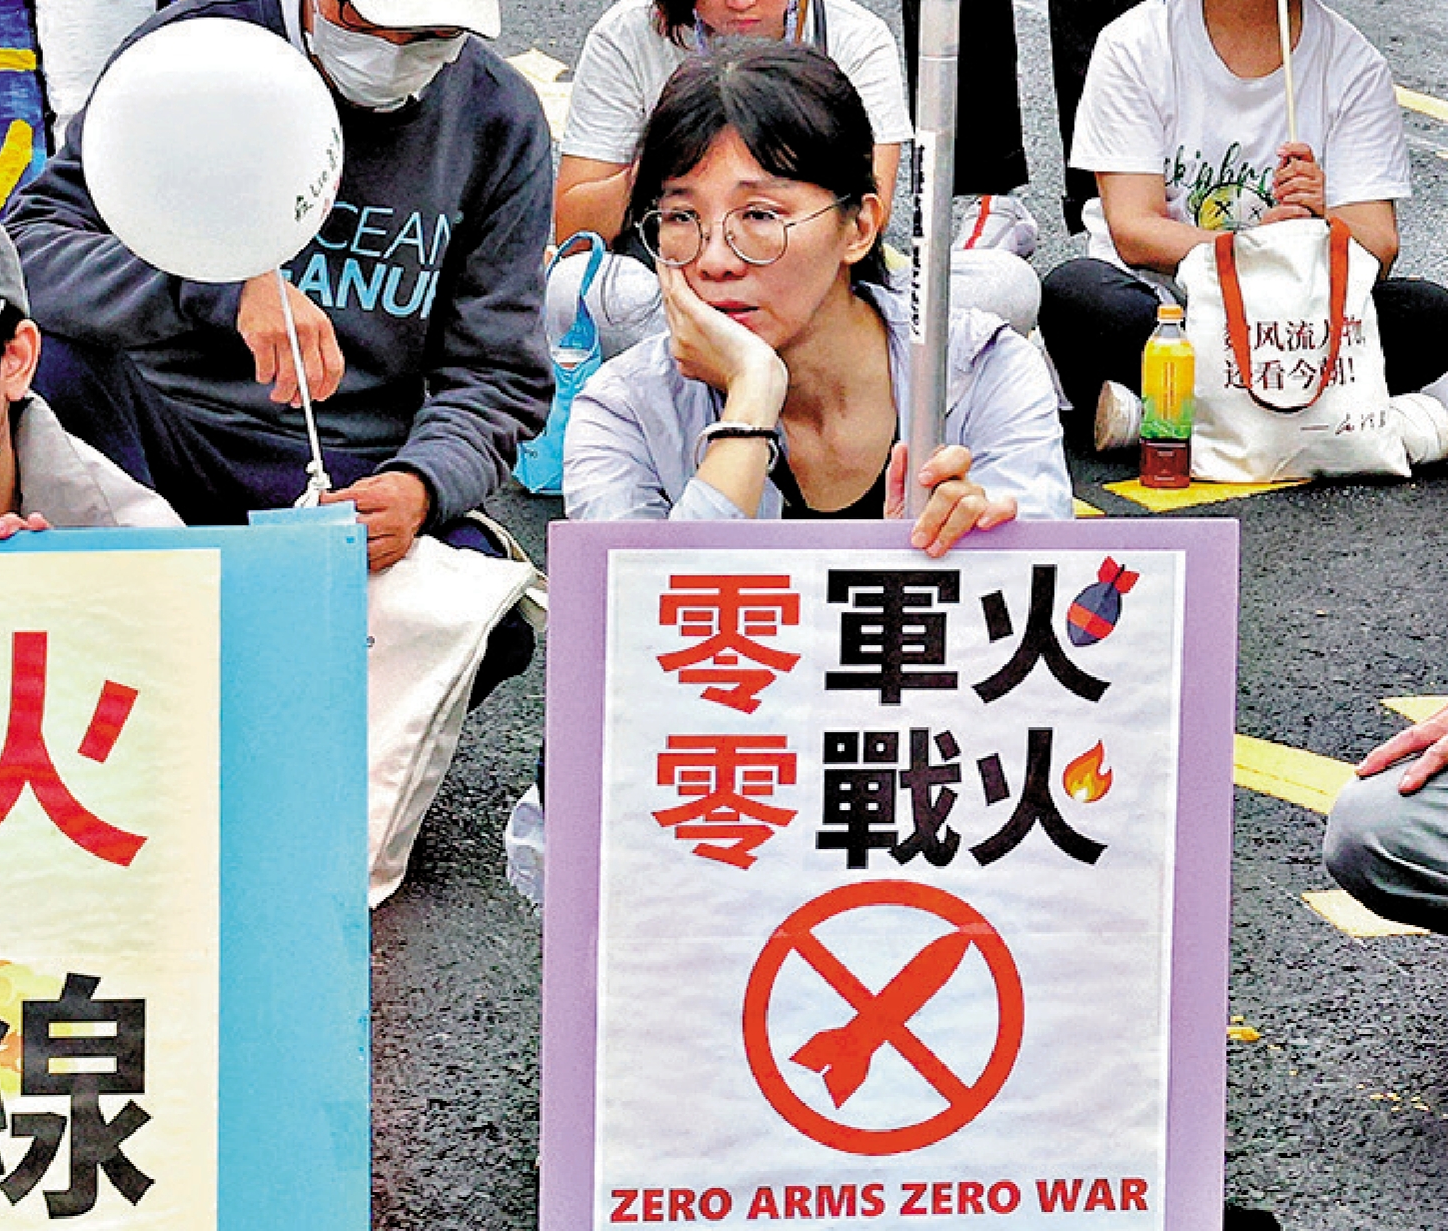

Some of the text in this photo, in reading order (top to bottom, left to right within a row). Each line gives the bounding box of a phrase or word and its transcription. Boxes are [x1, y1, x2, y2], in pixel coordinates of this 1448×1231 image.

[281, 254, 441, 320] ANU
[655, 564, 1112, 715] 零軍火
[651, 727, 1107, 871] 零戰火
[609, 1176, 1150, 1224] ZERO ARMS ZERO WAR
